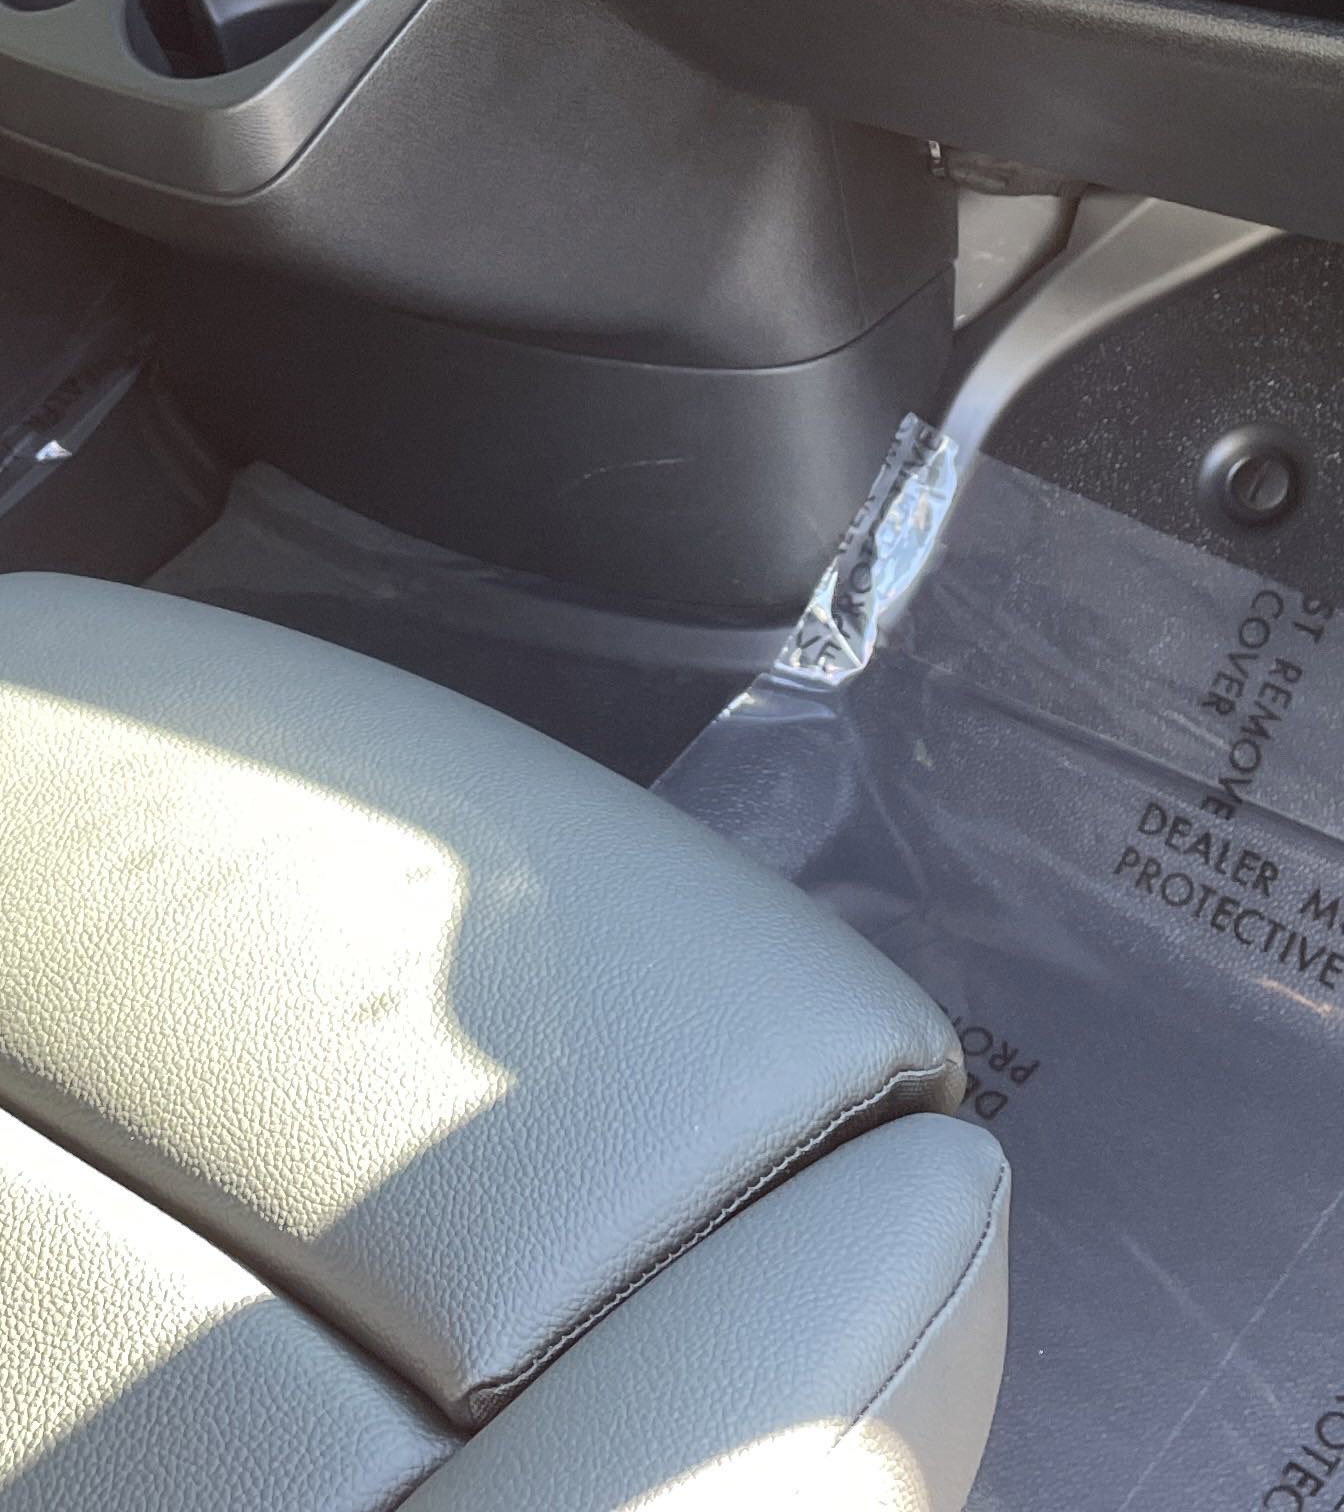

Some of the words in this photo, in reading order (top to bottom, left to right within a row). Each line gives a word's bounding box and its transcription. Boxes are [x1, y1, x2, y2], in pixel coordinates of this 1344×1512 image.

[1201, 590, 1285, 716] COVER
[1201, 657, 1304, 821] REMOVE
[1138, 801, 1280, 898] DEALER
[950, 1014, 1041, 1085] PRO
